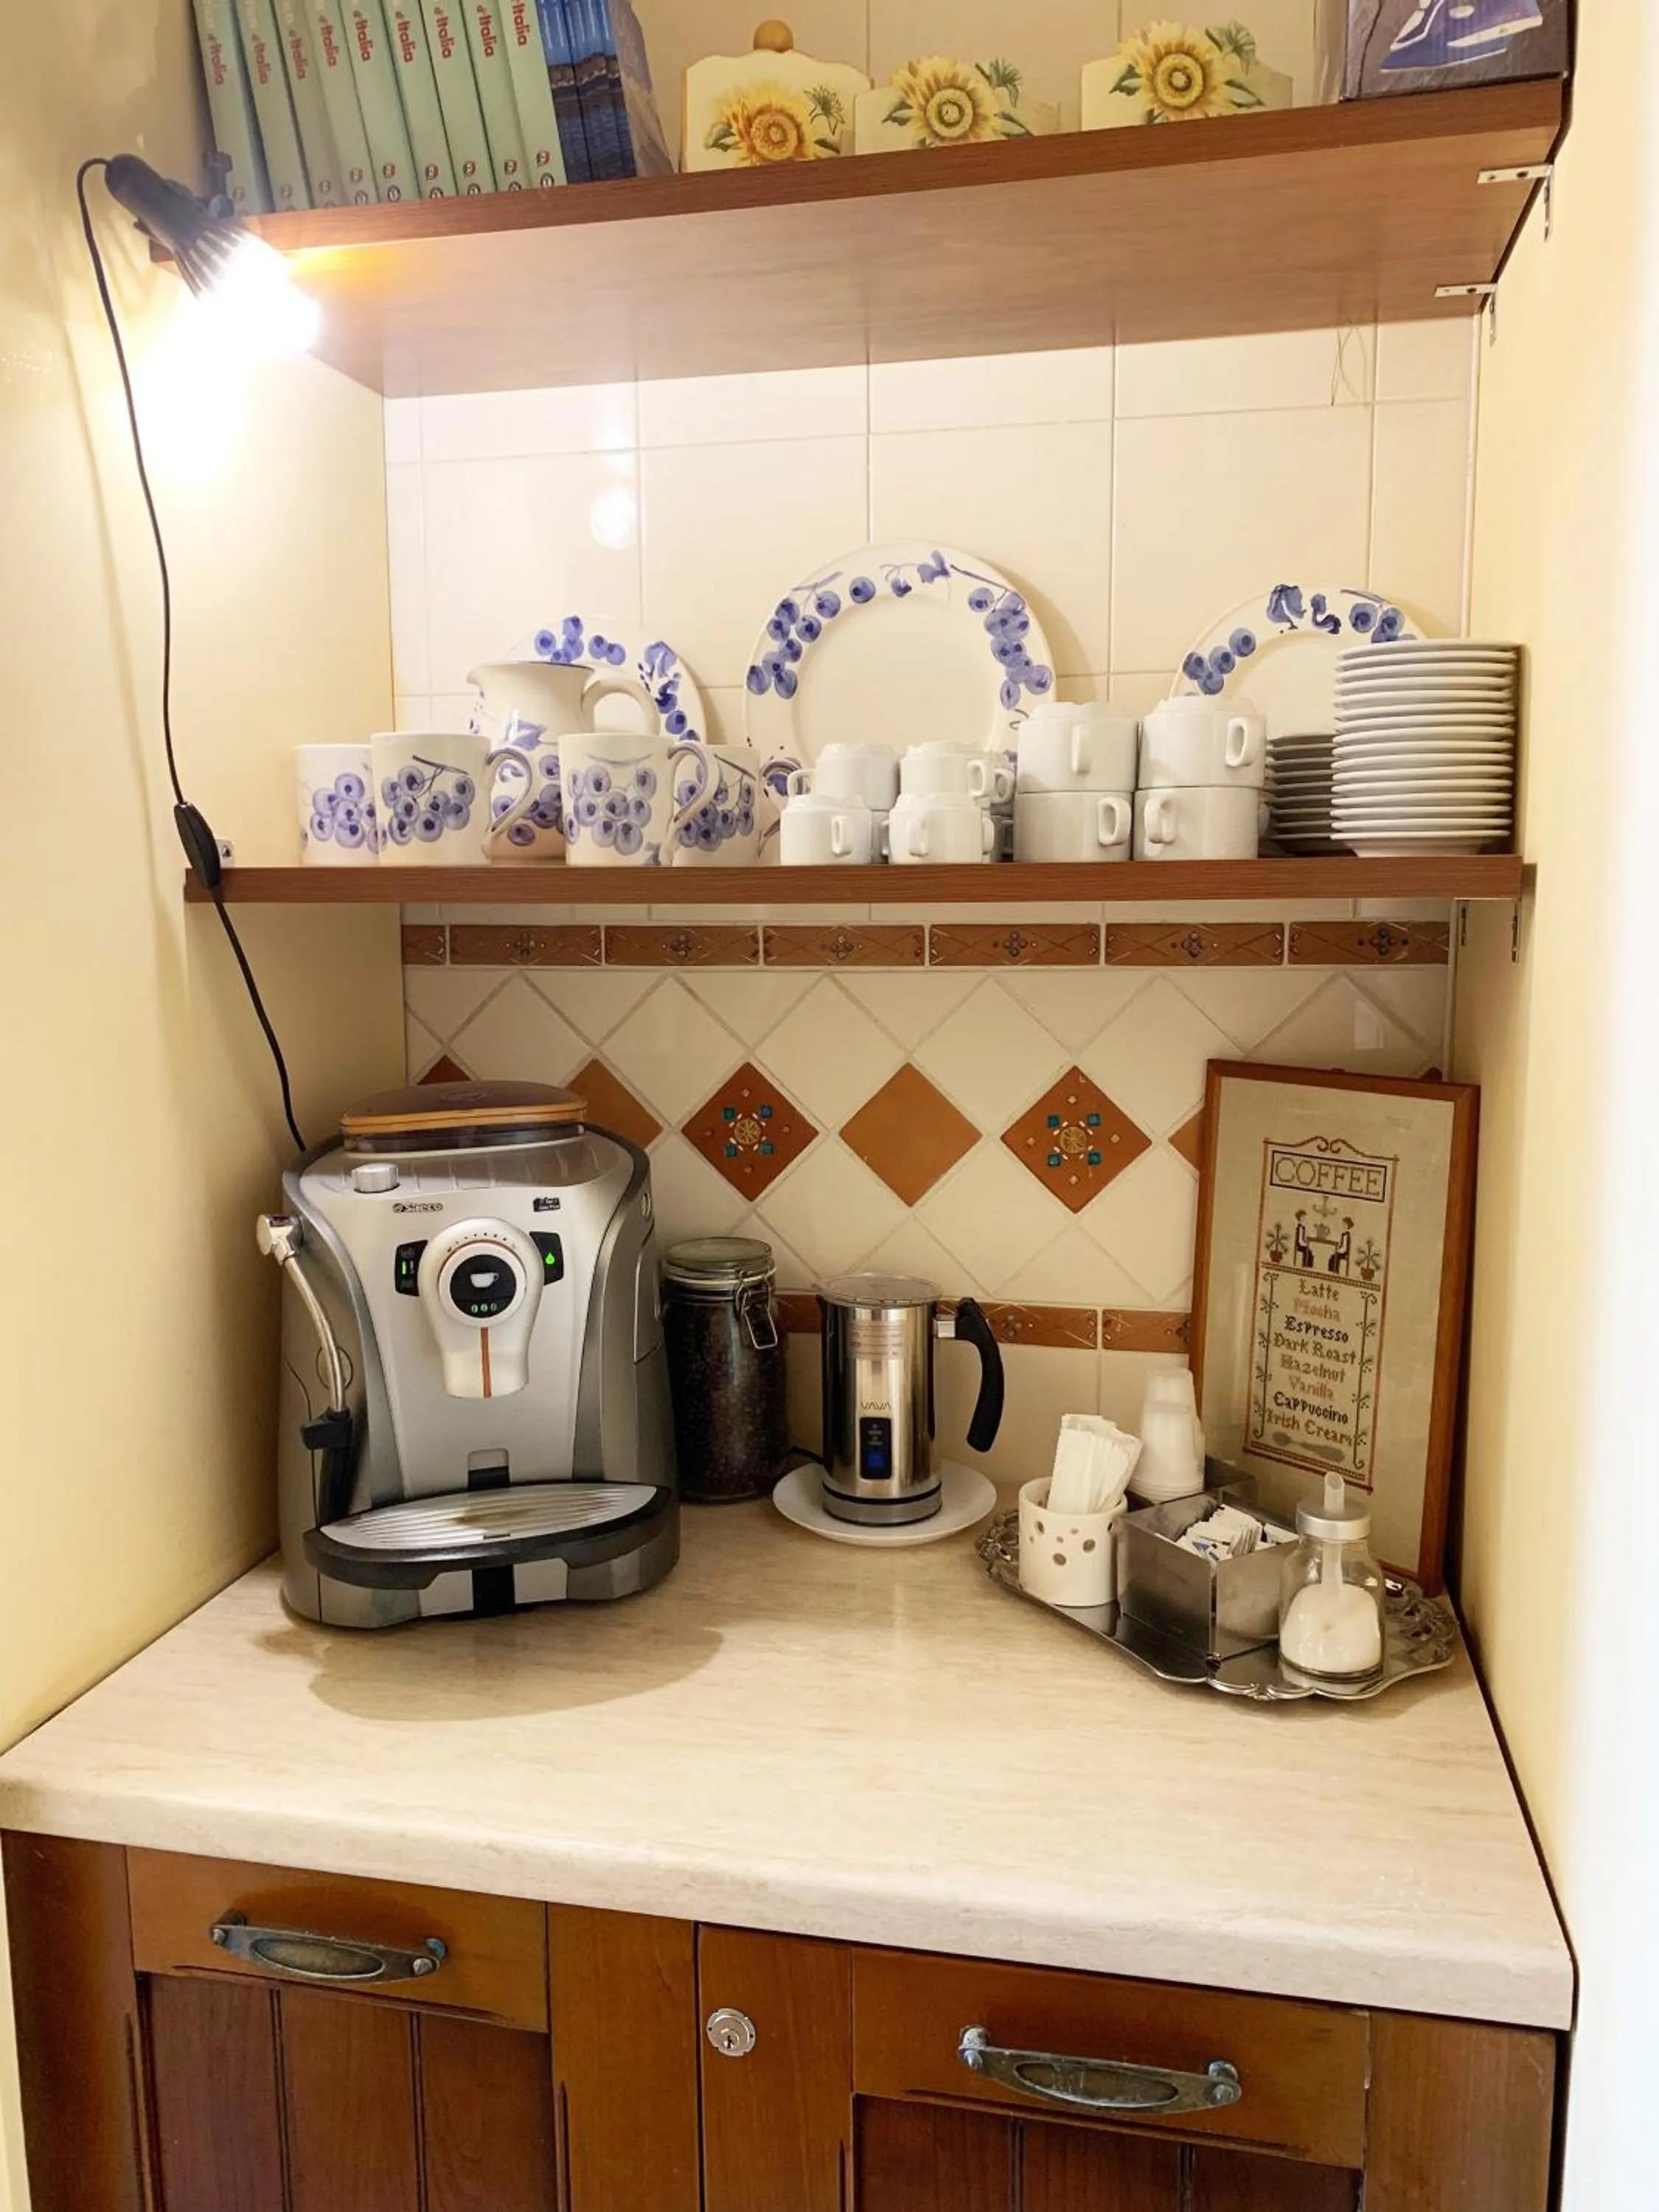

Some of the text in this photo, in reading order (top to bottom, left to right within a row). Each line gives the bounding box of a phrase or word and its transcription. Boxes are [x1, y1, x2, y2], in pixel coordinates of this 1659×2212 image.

[1275, 1156, 1382, 1196] COFFEE
[1299, 1279, 1340, 1301] Latte
[1284, 1315, 1349, 1343] Espresso
[1273, 1332, 1357, 1365] Dark Roast
[1281, 1353, 1346, 1383] Hazelnut
[1288, 1374, 1334, 1399] Vanilla
[1273, 1391, 1349, 1425] Cappuccino
[1266, 1408, 1352, 1446] Irish Cream
